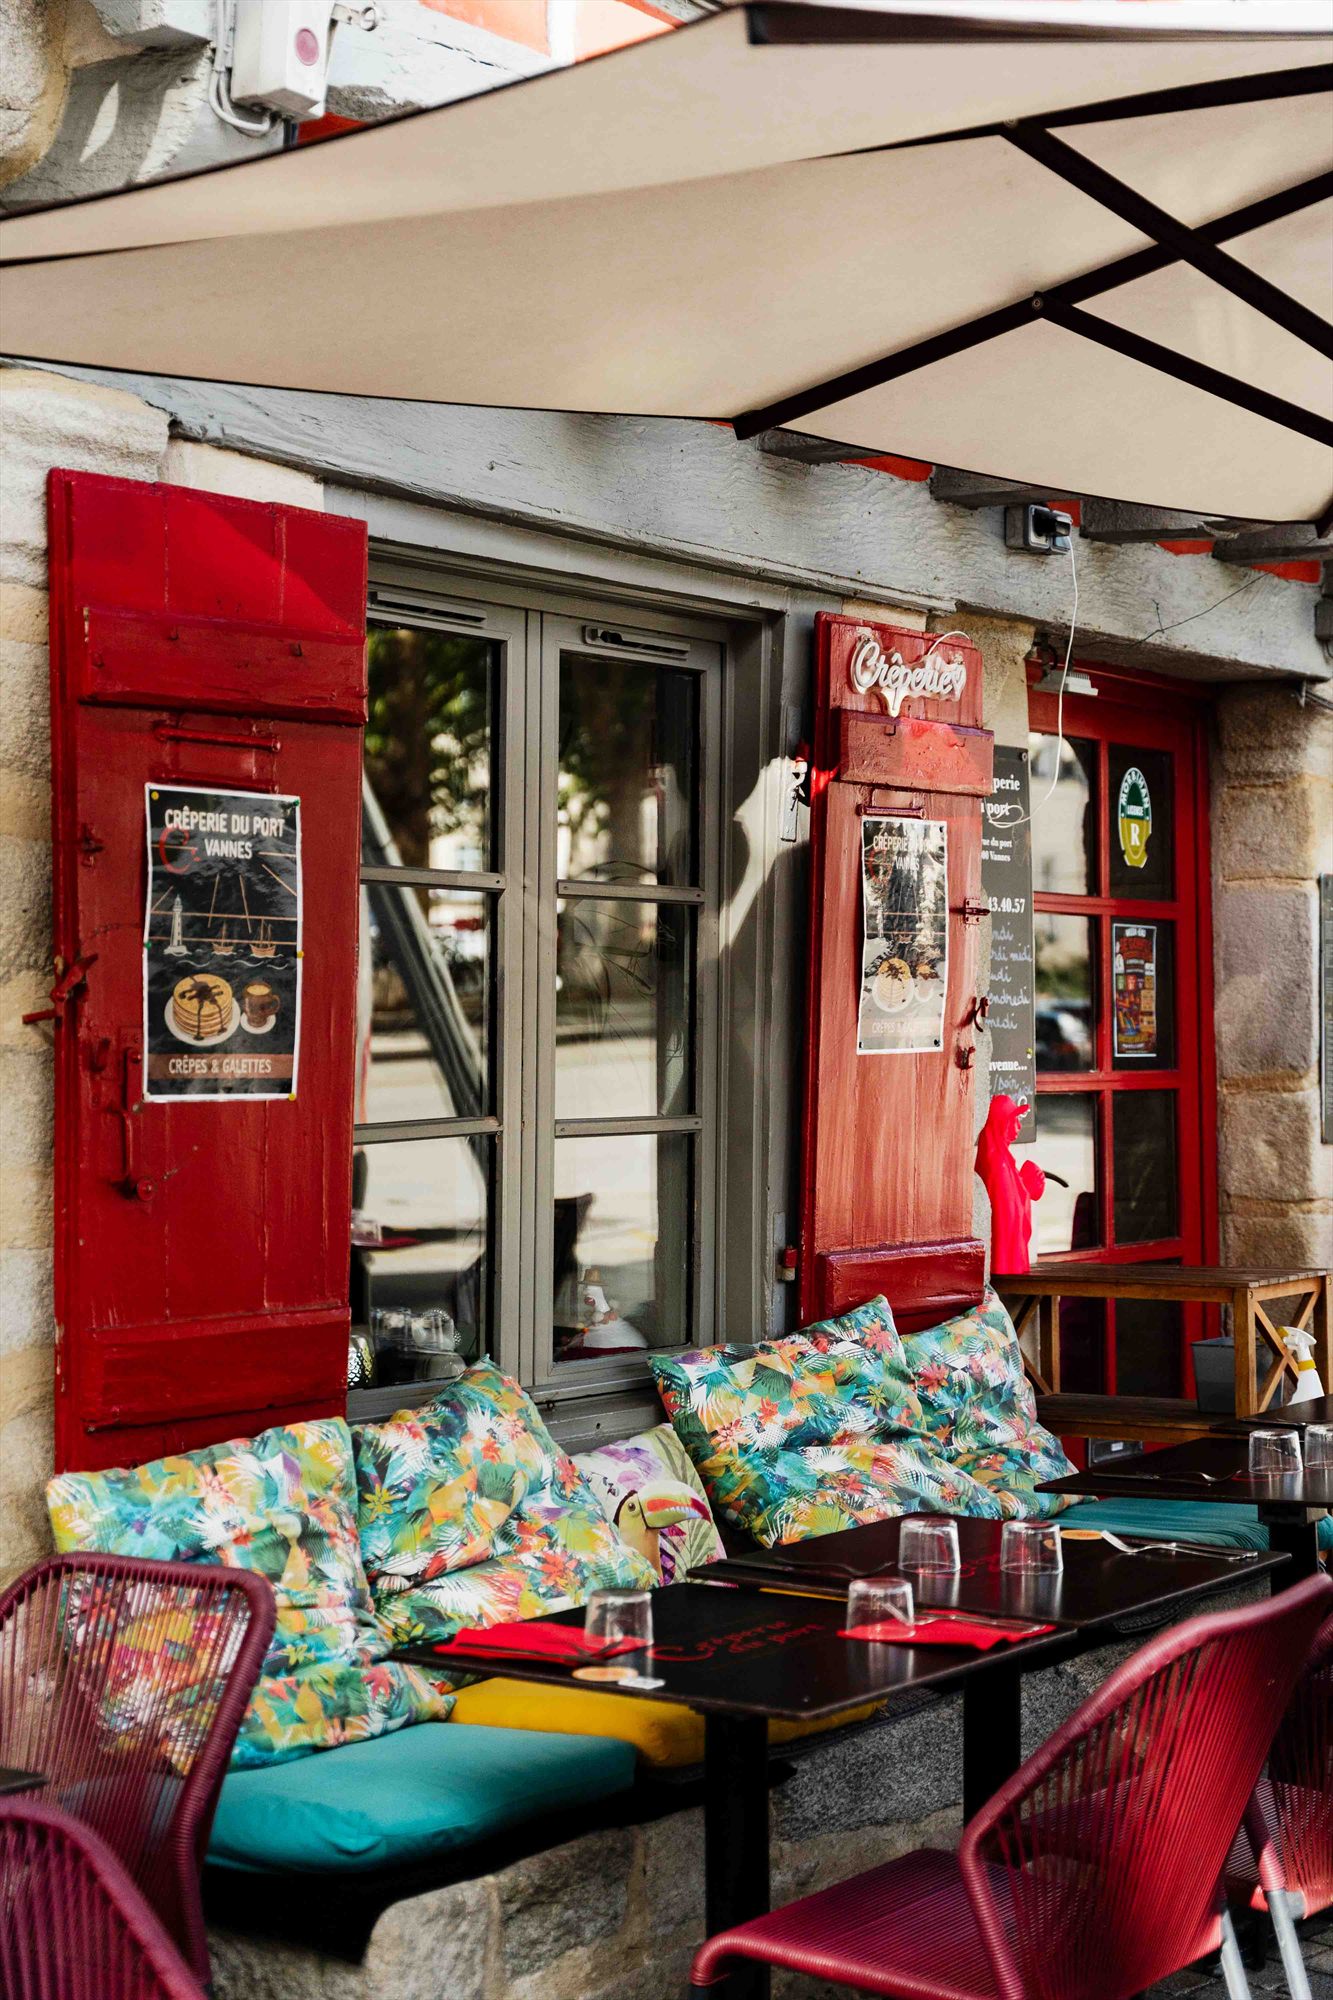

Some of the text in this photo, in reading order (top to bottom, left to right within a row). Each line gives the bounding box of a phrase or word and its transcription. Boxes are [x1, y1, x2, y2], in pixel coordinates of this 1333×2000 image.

[855, 640, 955, 711] Crêperie
[164, 805, 286, 838] CRÊPERIE DU PORT
[1130, 823, 1141, 846] R
[204, 838, 253, 860] VANNES
[168, 1054, 272, 1075] CRÊPES & GALETTES
